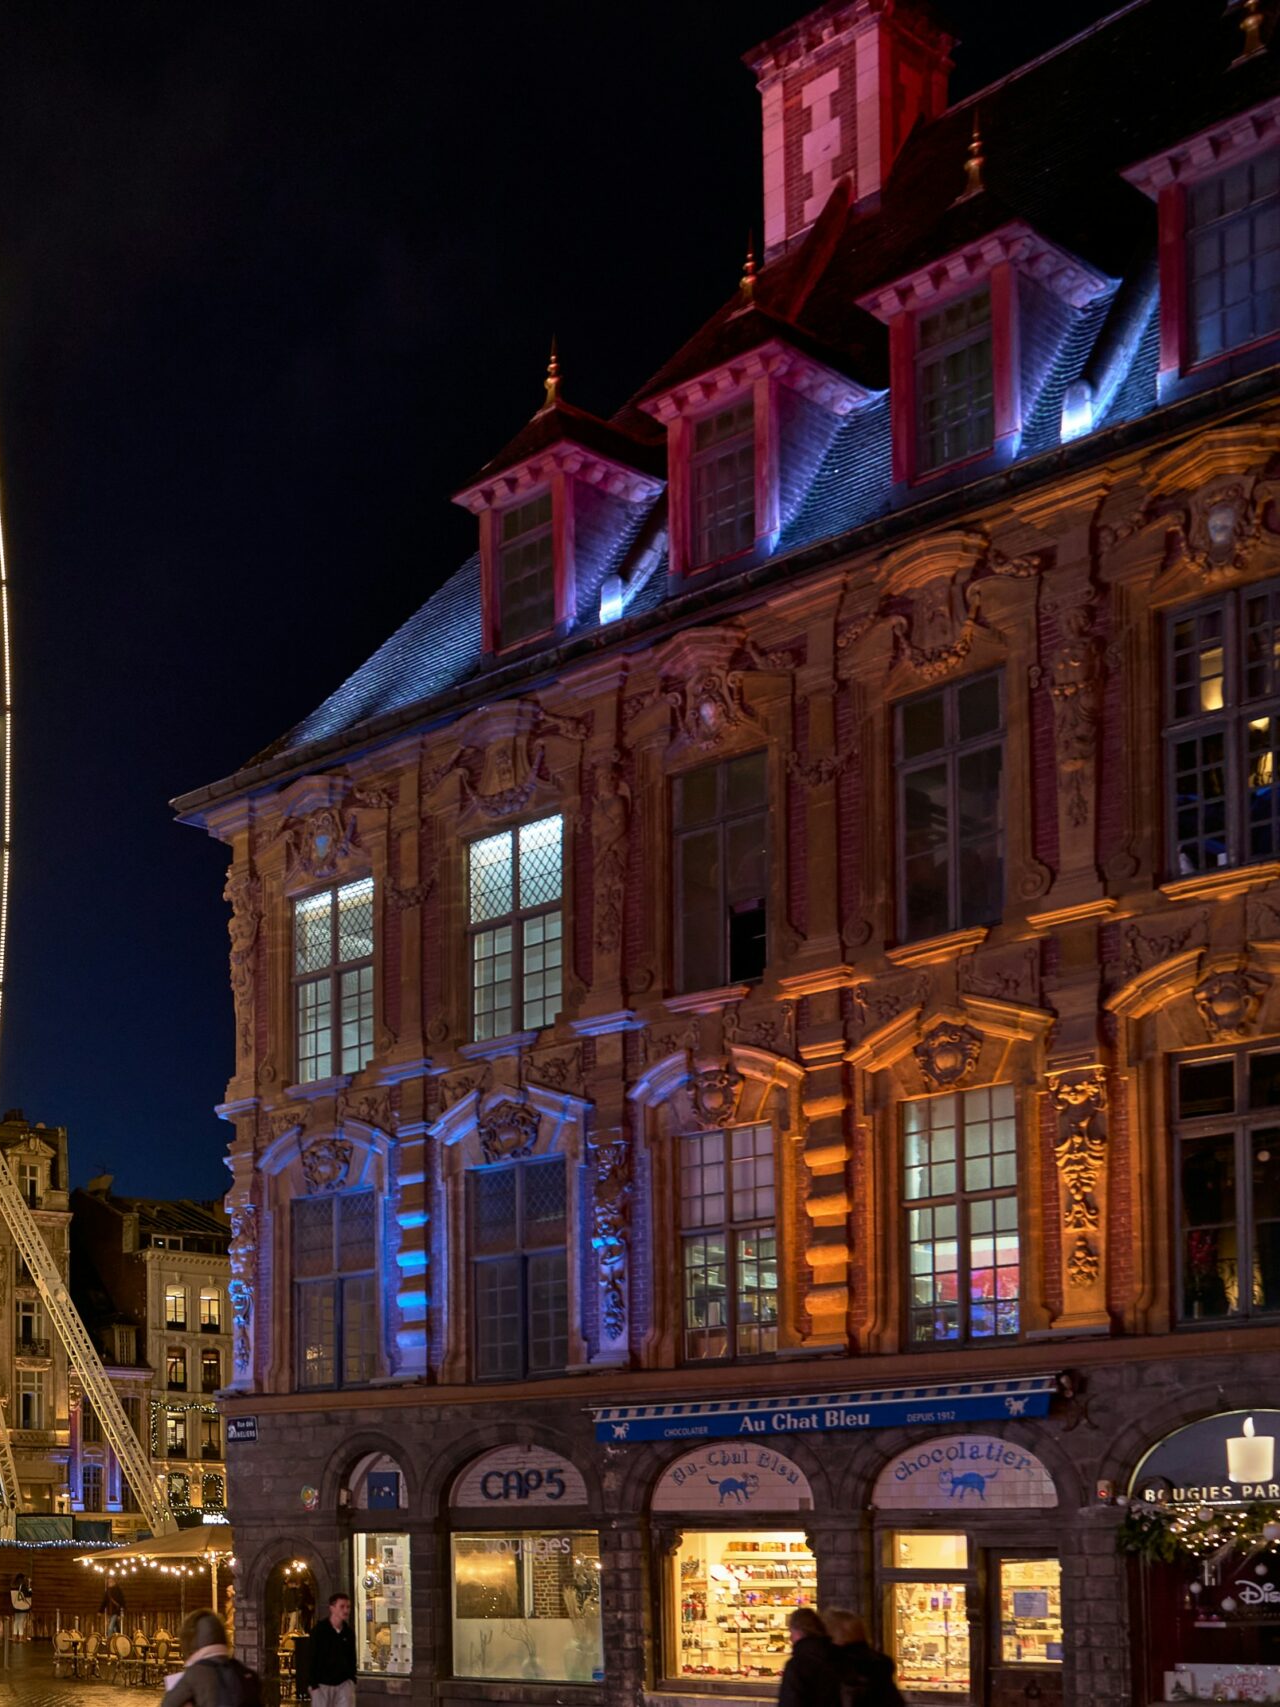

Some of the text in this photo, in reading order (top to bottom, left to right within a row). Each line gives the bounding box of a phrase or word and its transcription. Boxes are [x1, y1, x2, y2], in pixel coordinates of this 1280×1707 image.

[739, 1409, 871, 1432] Au Chat Bleu
[906, 1410, 956, 1422] DEPUIS 1912
[664, 1426, 709, 1437] CHOCOLATIER
[894, 1441, 1032, 1481] chocolatier
[484, 1537, 571, 1562] voyages
